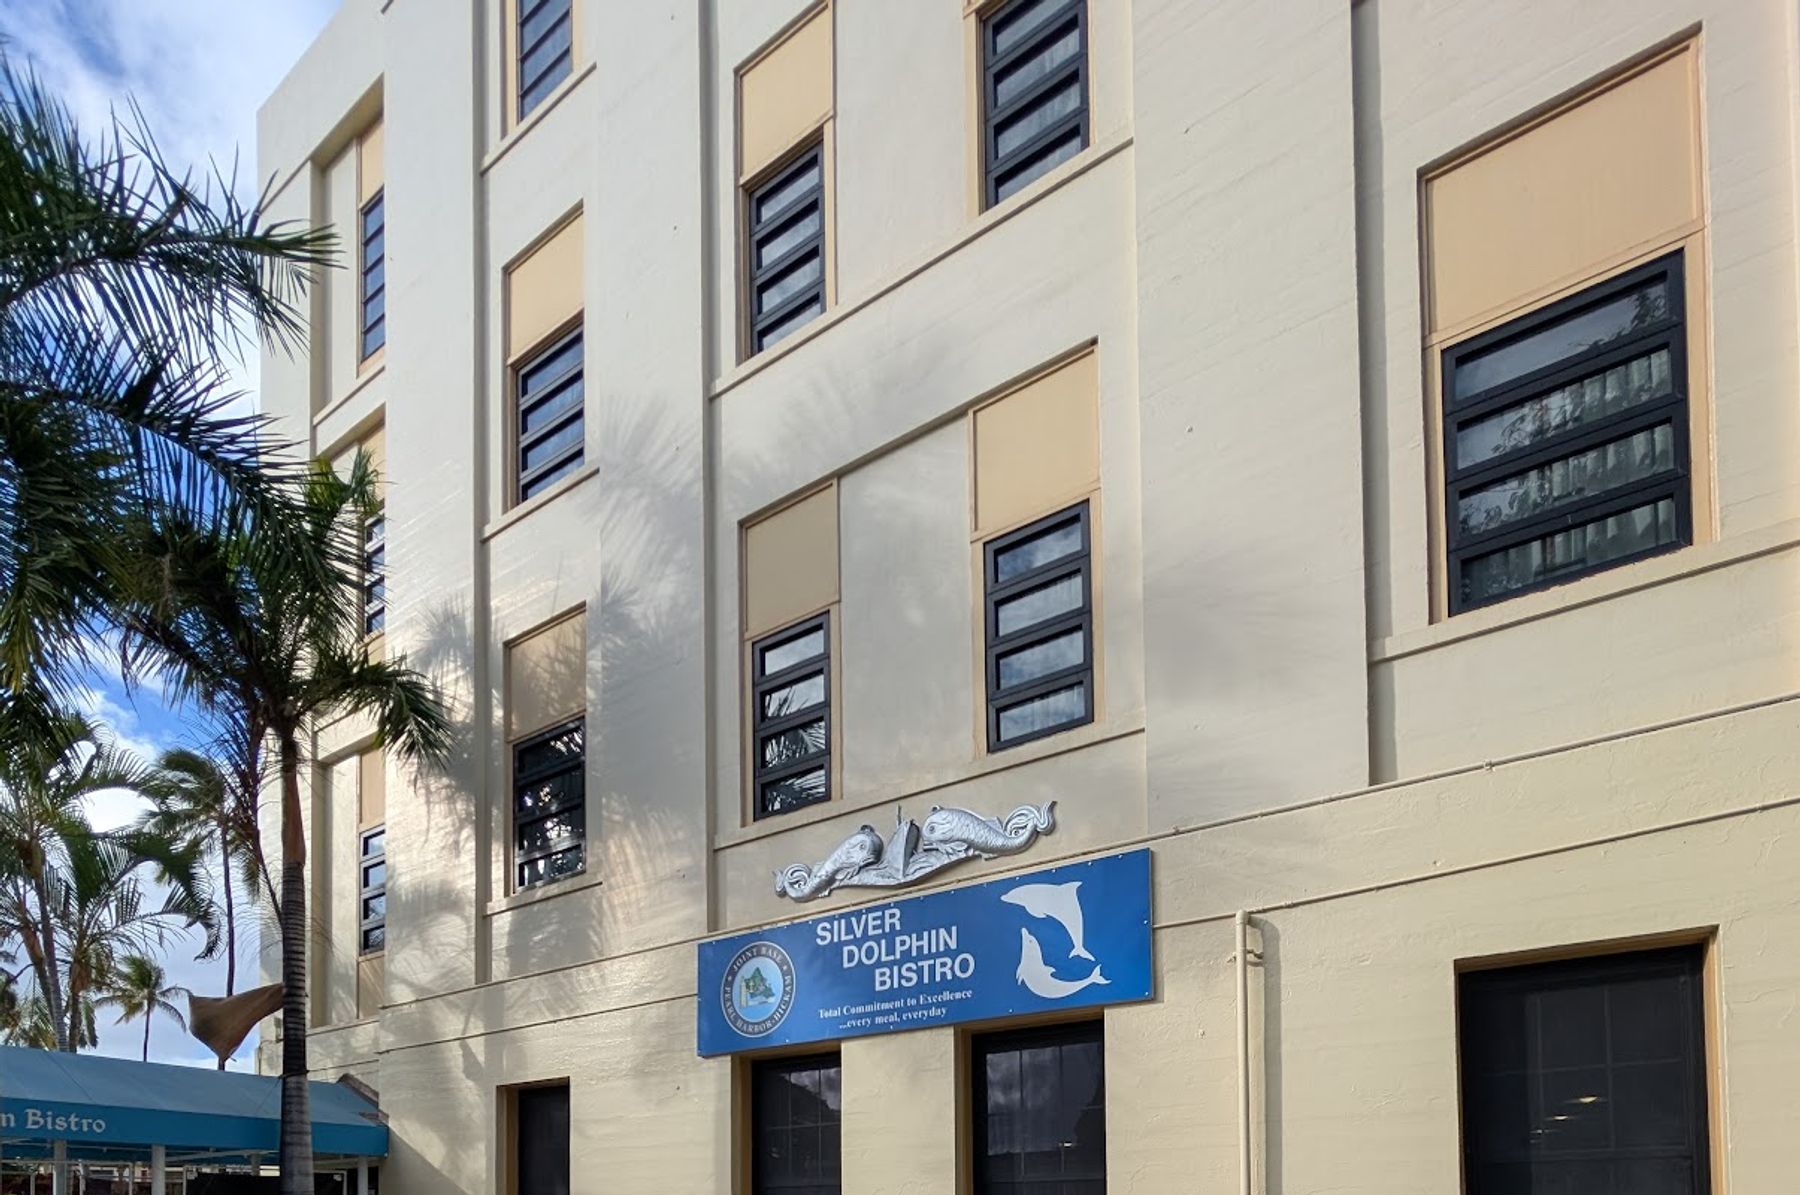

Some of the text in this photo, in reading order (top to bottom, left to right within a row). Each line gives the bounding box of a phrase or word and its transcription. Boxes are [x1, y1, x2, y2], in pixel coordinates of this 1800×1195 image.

[816, 908, 901, 945] SILVER
[733, 946, 783, 971] JOINT BASE
[842, 926, 957, 969] DOLPHIN
[875, 953, 975, 992] BISTRO
[724, 986, 737, 1019] PEARL
[818, 989, 973, 1018] Total Commitment to Excellence
[875, 1012, 900, 1024] meal,
[902, 1007, 947, 1021] everyday
[24, 1108, 106, 1133] Bistro
